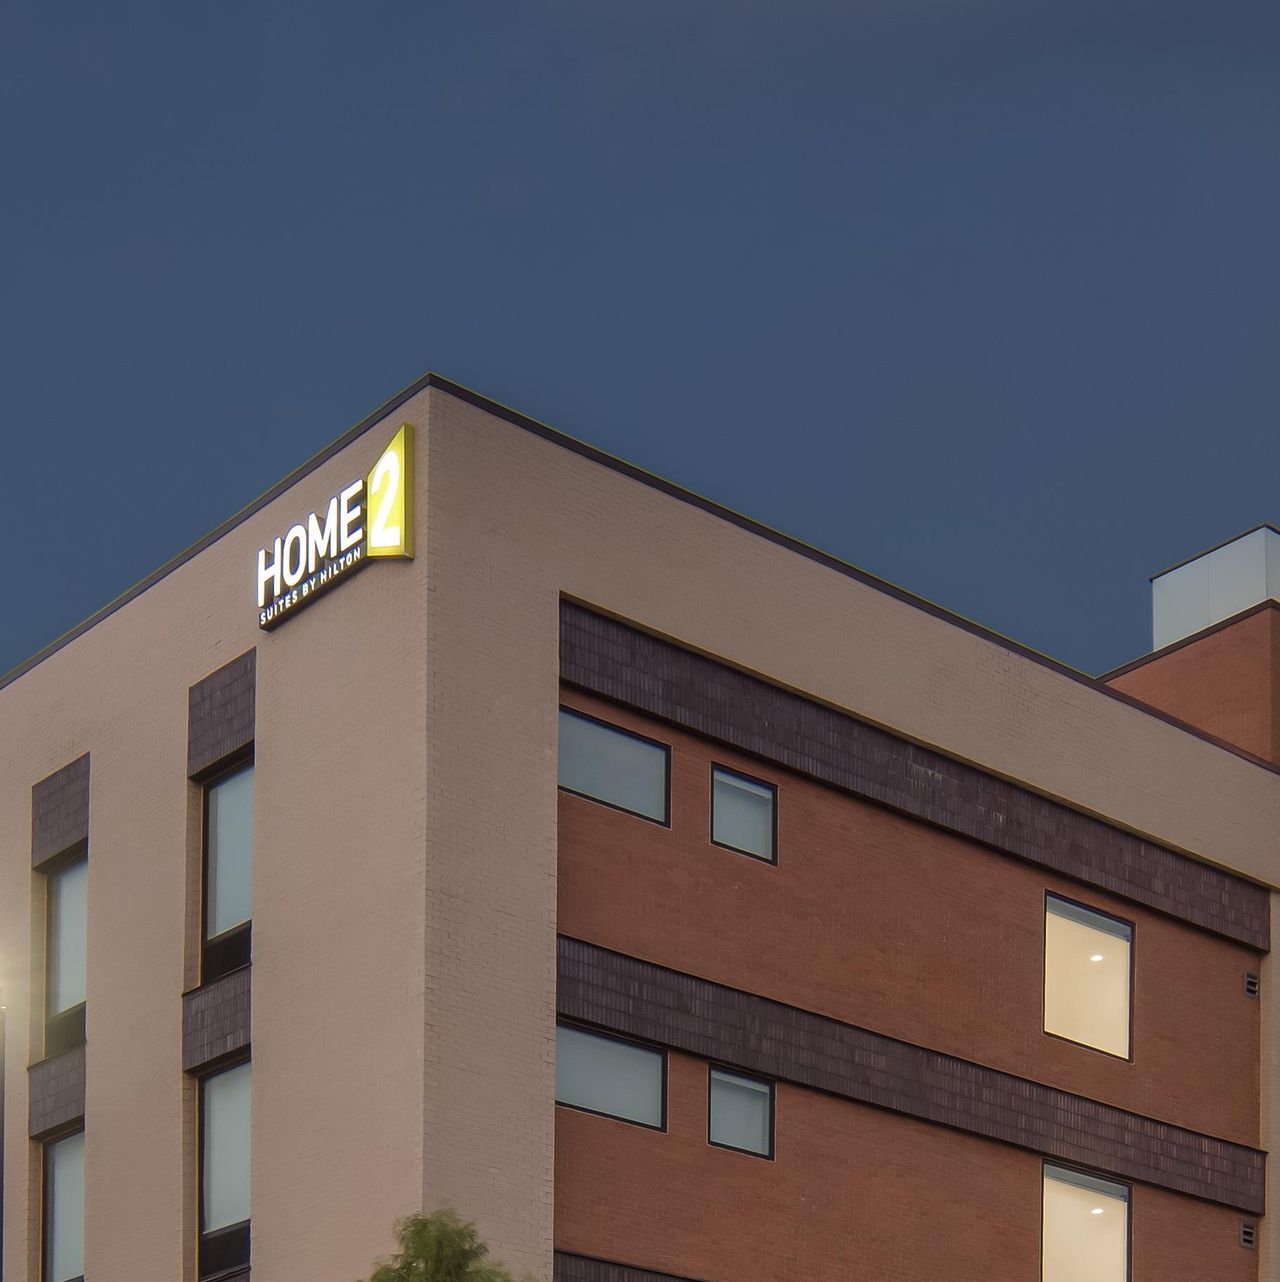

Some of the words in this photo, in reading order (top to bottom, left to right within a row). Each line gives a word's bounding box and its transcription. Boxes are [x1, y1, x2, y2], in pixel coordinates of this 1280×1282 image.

[257, 478, 364, 608] HOME
[370, 450, 401, 548] 2
[260, 590, 298, 625] SUITES
[302, 578, 317, 598] BY
[320, 547, 361, 585] HILTON
